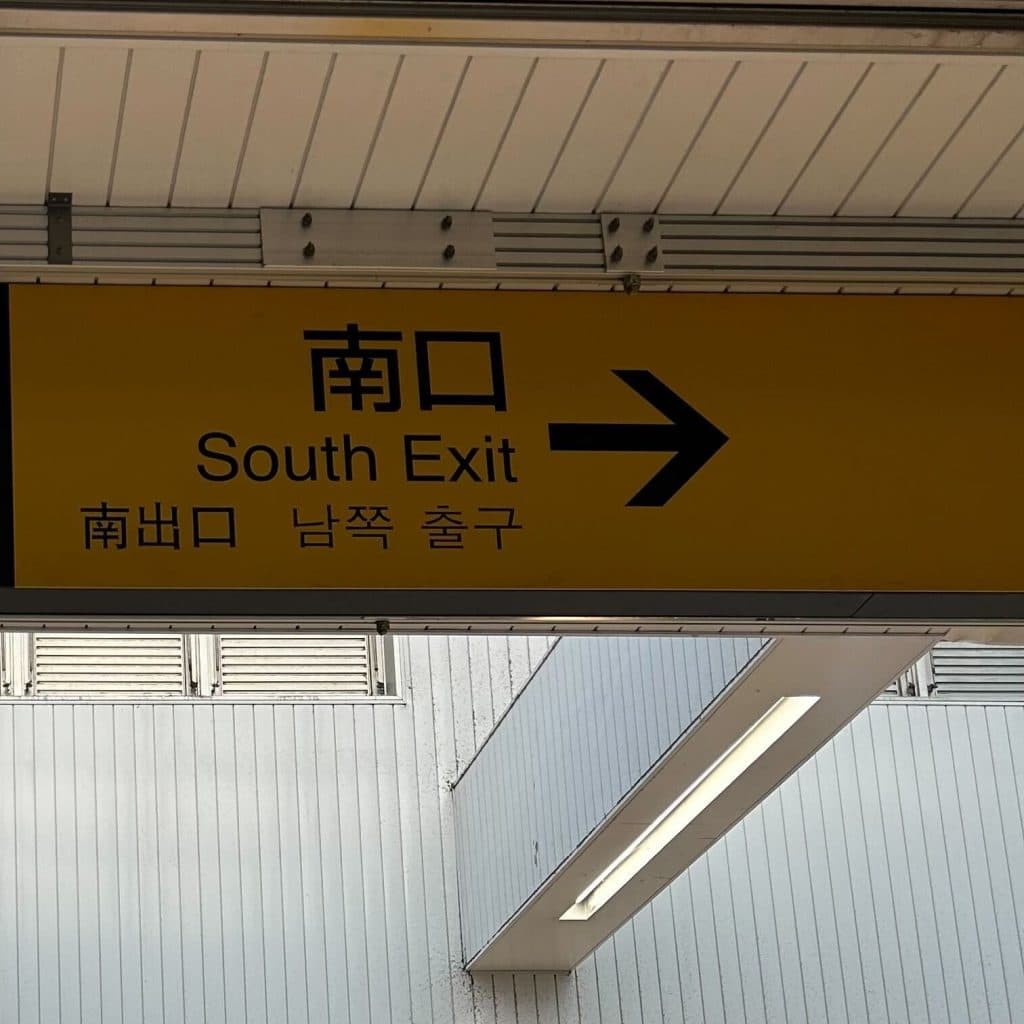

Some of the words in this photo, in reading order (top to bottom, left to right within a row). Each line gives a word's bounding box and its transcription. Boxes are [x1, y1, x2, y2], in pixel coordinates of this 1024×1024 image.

[303, 323, 508, 413] 南口
[196, 431, 377, 484] South
[403, 434, 518, 484] Exit
[81, 502, 238, 551] 南出口
[292, 504, 395, 550] 남쪽
[420, 504, 524, 550] 출구
